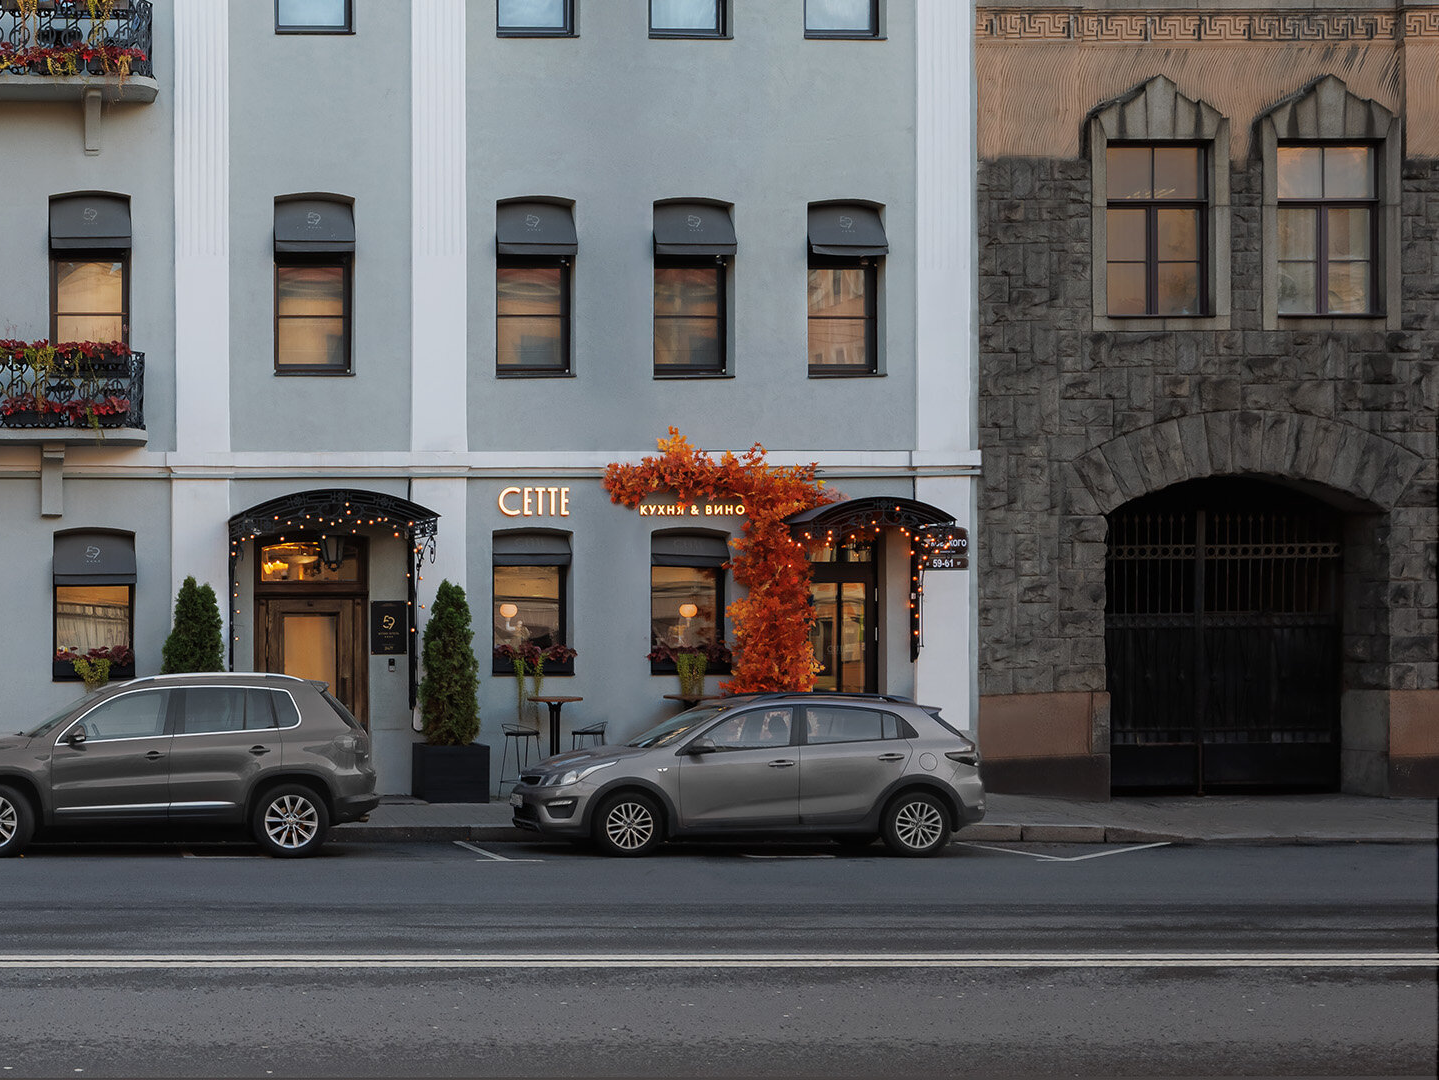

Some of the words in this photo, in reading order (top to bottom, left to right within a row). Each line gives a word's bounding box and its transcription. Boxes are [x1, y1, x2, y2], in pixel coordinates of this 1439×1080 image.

[497, 486, 570, 516] CETTE
[639, 504, 685, 516] КУХНЯ
[690, 505, 699, 515] &
[705, 504, 746, 516] ВИНО
[932, 558, 954, 568] 59-61
[382, 615, 395, 630] 59
